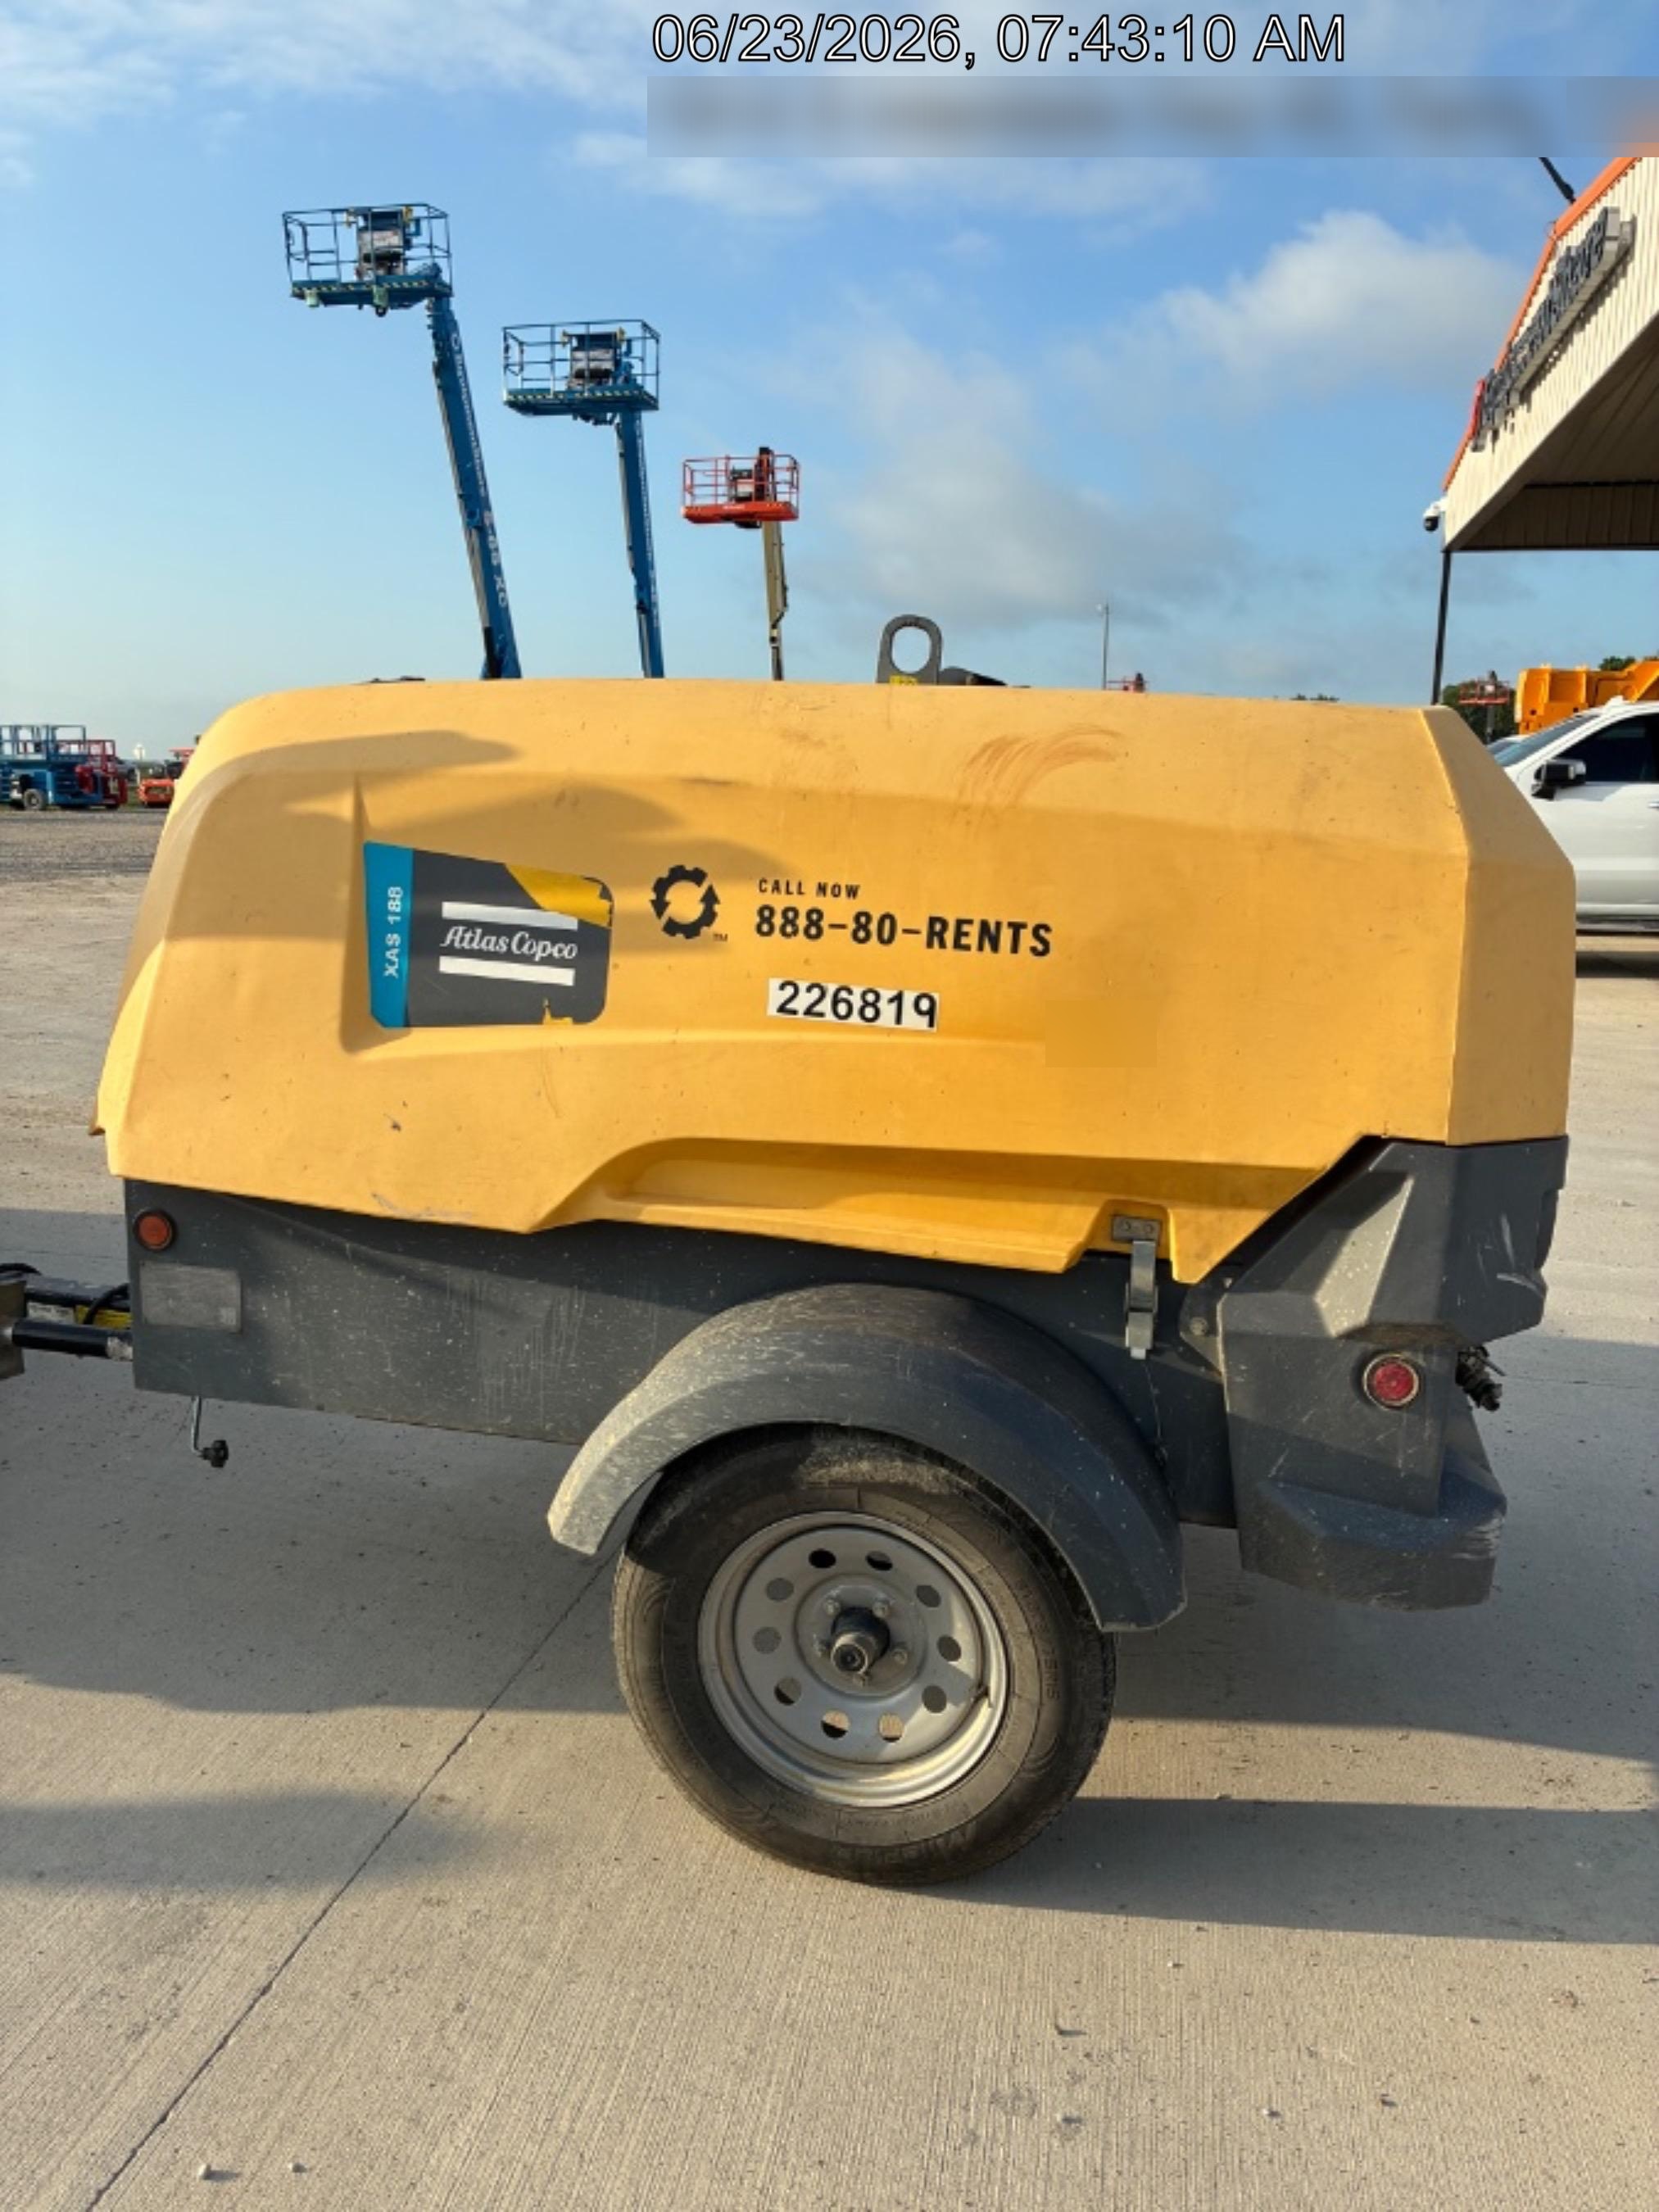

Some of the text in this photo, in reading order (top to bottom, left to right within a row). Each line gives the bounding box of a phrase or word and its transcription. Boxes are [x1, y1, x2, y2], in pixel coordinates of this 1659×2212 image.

[758, 877, 860, 900] CALL NOW
[383, 886, 404, 978] XAS 188
[440, 925, 578, 962] Atlas Copco
[755, 904, 1053, 958] 888-80-RENTS
[776, 979, 936, 1029] 226819
